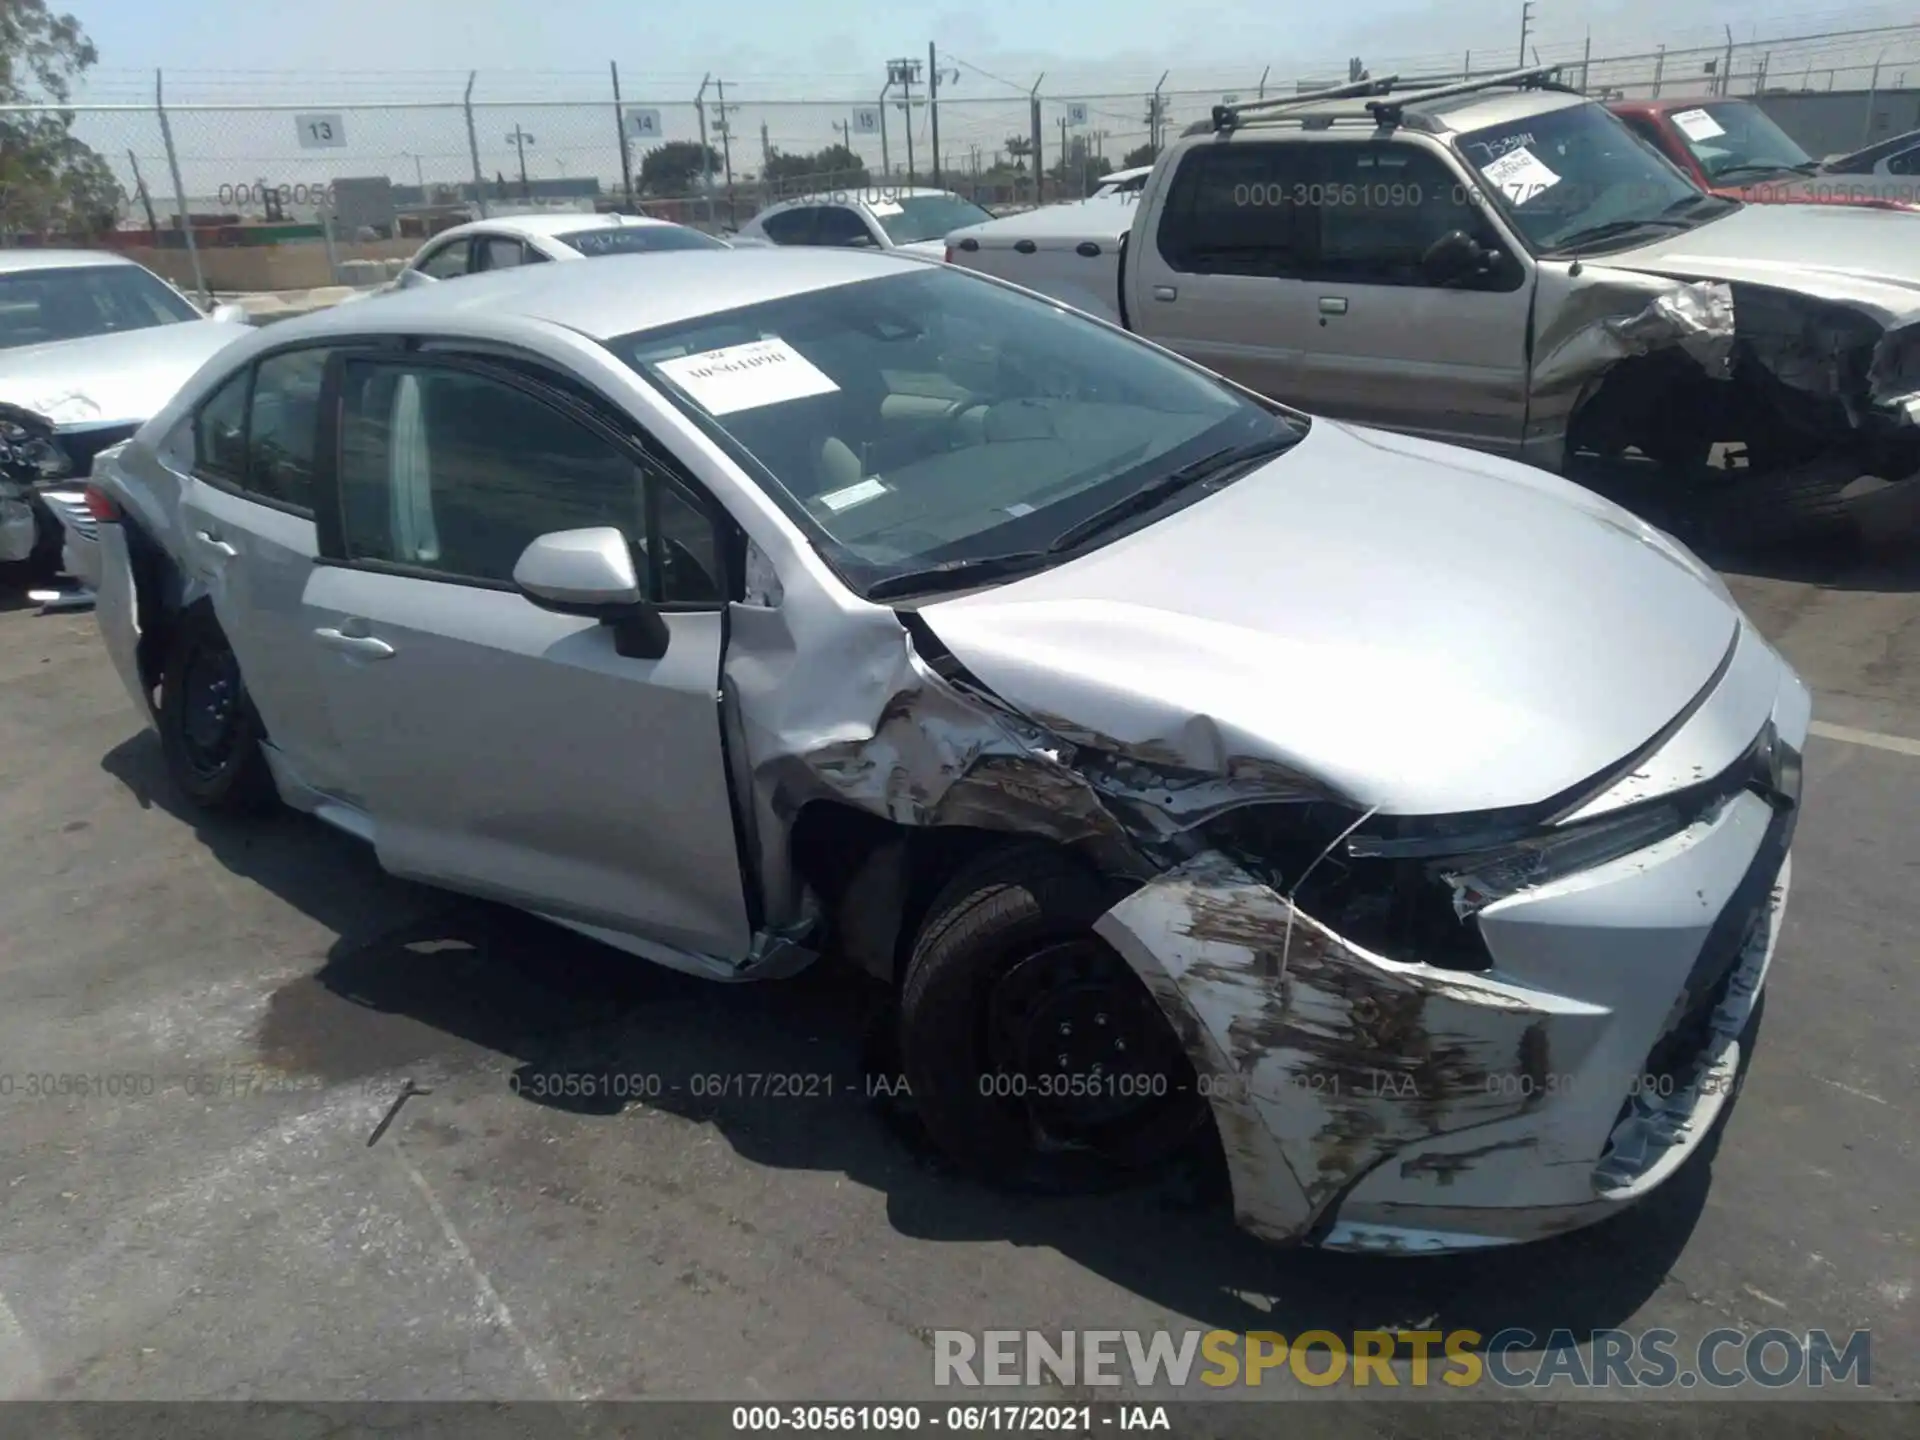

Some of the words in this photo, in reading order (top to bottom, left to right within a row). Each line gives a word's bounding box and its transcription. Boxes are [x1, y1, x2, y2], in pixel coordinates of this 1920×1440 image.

[635, 116, 652, 131] 14
[860, 112, 874, 129] 15
[308, 121, 333, 141] 13
